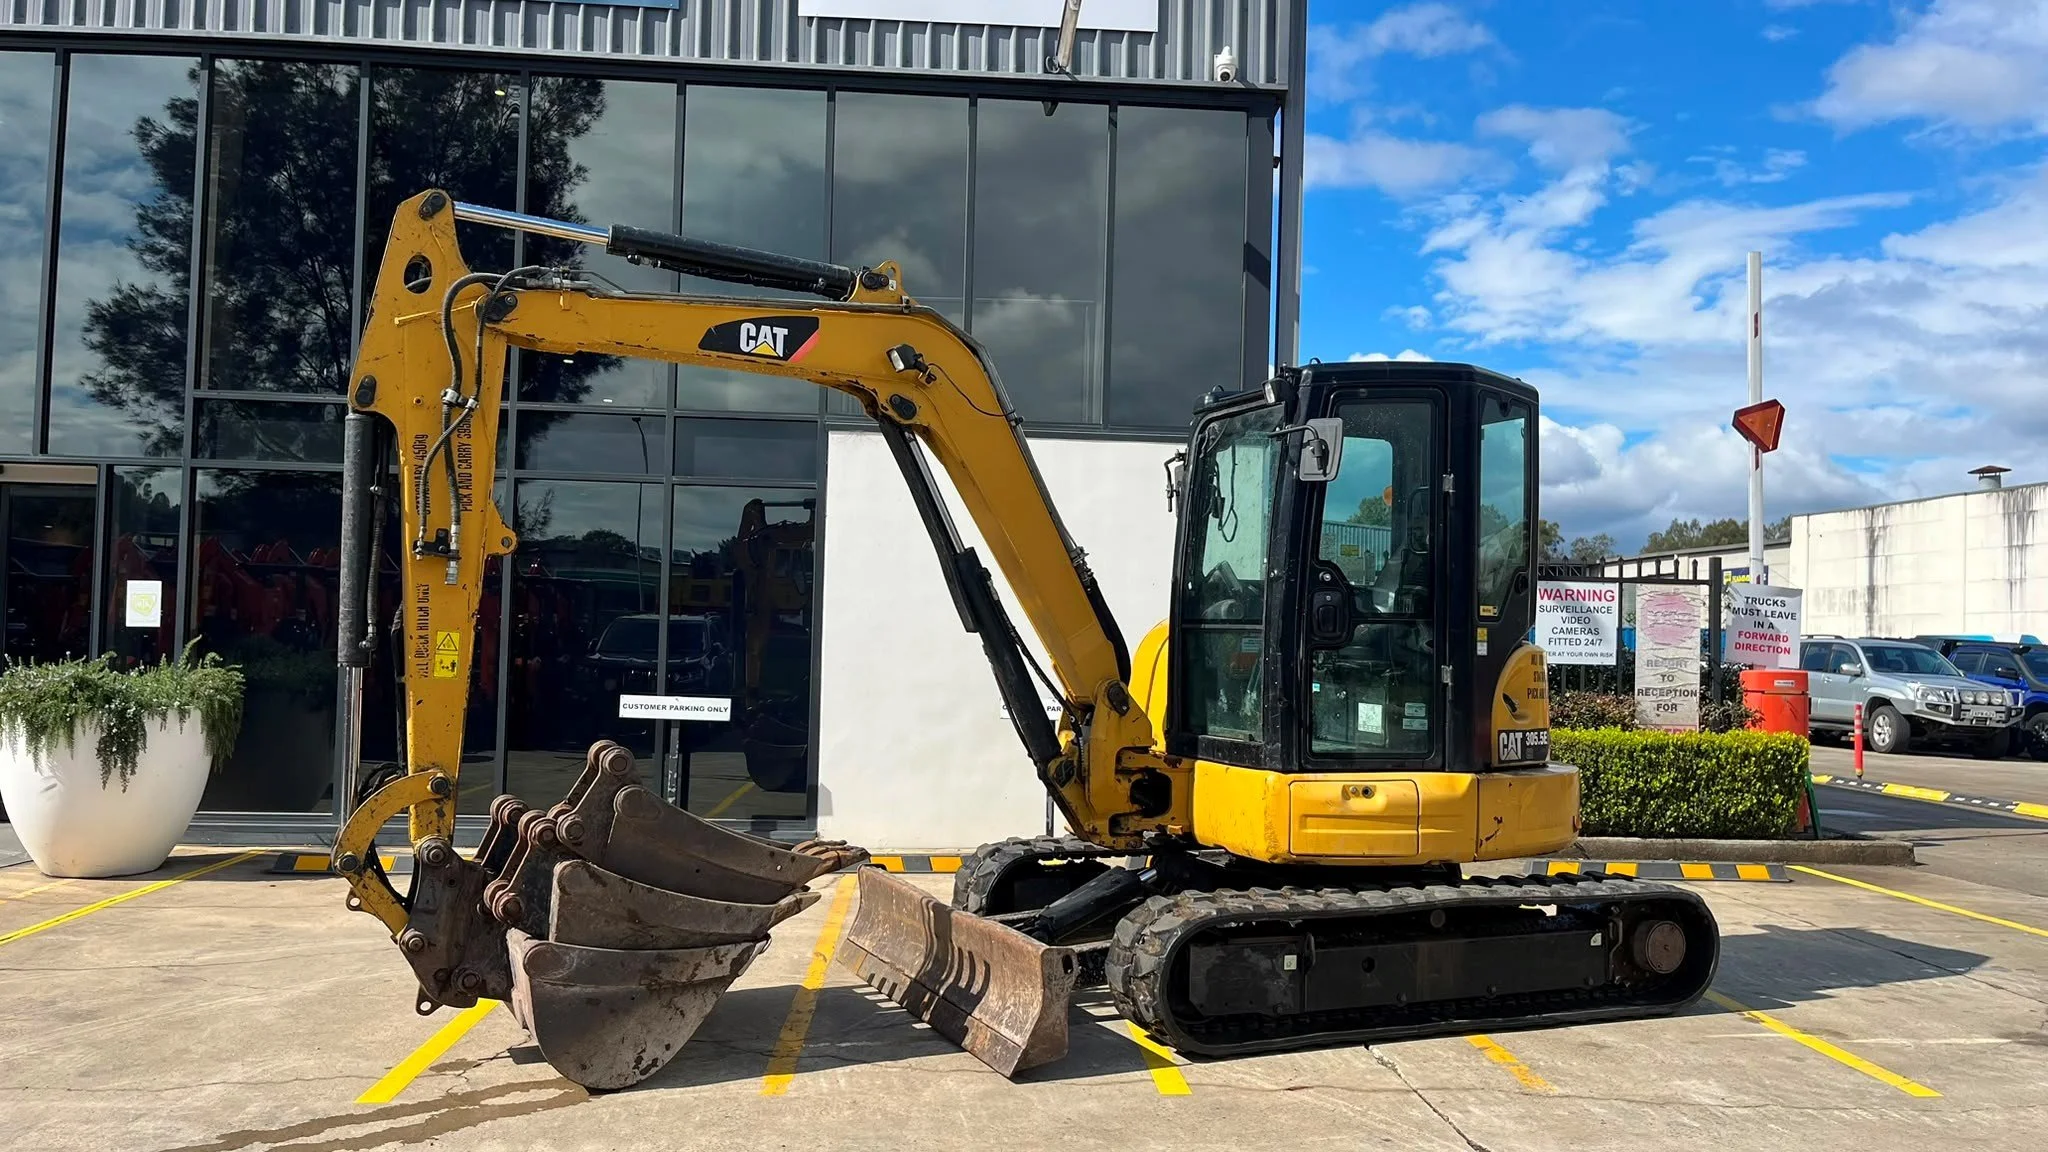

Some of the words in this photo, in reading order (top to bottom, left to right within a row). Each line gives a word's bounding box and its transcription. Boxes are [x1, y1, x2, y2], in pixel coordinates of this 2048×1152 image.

[740, 322, 788, 357] CAT
[457, 441, 472, 469] CARRY
[458, 472, 472, 490] AND
[1539, 588, 1615, 602] WARNING
[1744, 596, 1786, 607] TRUCKS
[1539, 605, 1613, 614] SURVEILLANCE
[1732, 607, 1761, 617] MUST
[1765, 610, 1797, 620] LEAVE
[1561, 616, 1591, 624] VIDEO
[1754, 621, 1764, 629] IN
[1552, 627, 1600, 635] CAMERAS
[1548, 638, 1581, 646] FITTED
[1584, 638, 1602, 646] 24/7
[1738, 631, 1789, 643] FORWARD
[1734, 642, 1790, 654] DIRECTION
[1660, 674, 1675, 682] TO
[1637, 688, 1698, 697] RECEPTION
[622, 703, 667, 711] CUSTOMER
[1657, 703, 1677, 711] FOR
[1500, 732, 1522, 760] CAT
